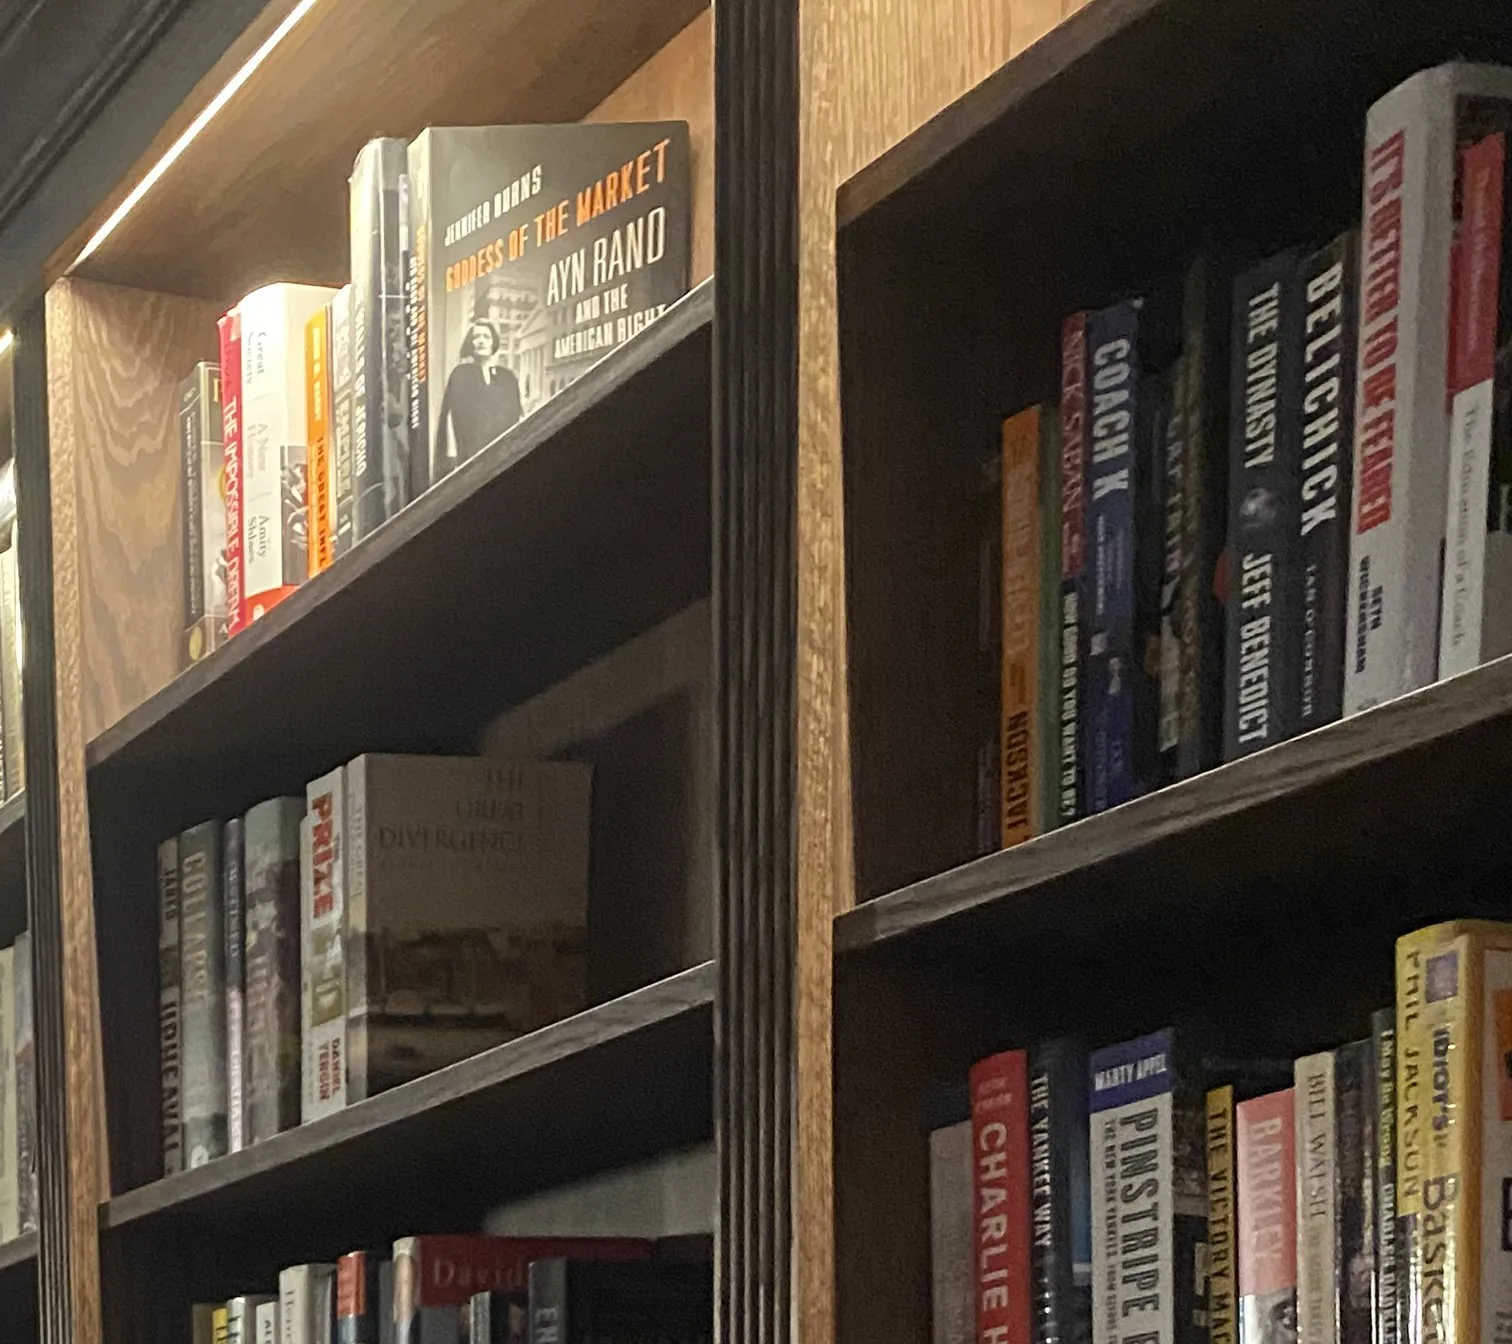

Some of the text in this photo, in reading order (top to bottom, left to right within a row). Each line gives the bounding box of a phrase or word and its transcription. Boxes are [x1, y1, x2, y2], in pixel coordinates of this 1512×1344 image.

[445, 164, 543, 246] JENNIFER BURNS
[446, 138, 671, 292] GODDESS OF THE MARKET
[547, 206, 666, 306] AYN RAND
[555, 319, 613, 358] AMERICAN
[576, 283, 628, 324] AND THE
[1356, 130, 1405, 535] IT'S BETTER TO BE FEARED
[224, 396, 237, 438] THE
[354, 306, 367, 476] WALLS OF JERICHO
[1062, 331, 1083, 512] NICK SABAN
[1092, 338, 1131, 464] COACH
[1244, 282, 1278, 468] THE DYNASTY
[1300, 261, 1342, 535] BELICHICK
[225, 440, 238, 551] IMPOSSIBLE
[316, 436, 326, 466] THE
[1093, 468, 1129, 500] K
[256, 514, 269, 559] Amity
[1237, 553, 1271, 745] JEFF BENEDICT
[1371, 586, 1384, 629] SETH
[1062, 694, 1078, 722] YOU
[1062, 722, 1078, 771] WANT
[1006, 712, 1029, 828] JACKSON
[313, 792, 334, 918] PRIZE
[319, 1041, 330, 1100] YERGIN
[330, 1038, 341, 1094] DANIEL
[1031, 1073, 1052, 1247] THE YANKEE WAY
[1105, 1120, 1118, 1140] THE
[1105, 1144, 1118, 1169] NEW
[1206, 1107, 1229, 1162] THE
[1306, 1073, 1327, 1222] BILL WALSH
[978, 1123, 1008, 1310] CHARLIE
[1105, 1173, 1118, 1203] YORK
[1120, 1109, 1161, 1313] PINSTRIPE
[1208, 1168, 1231, 1281] VICTORY
[1251, 1117, 1286, 1261] BARKLEY
